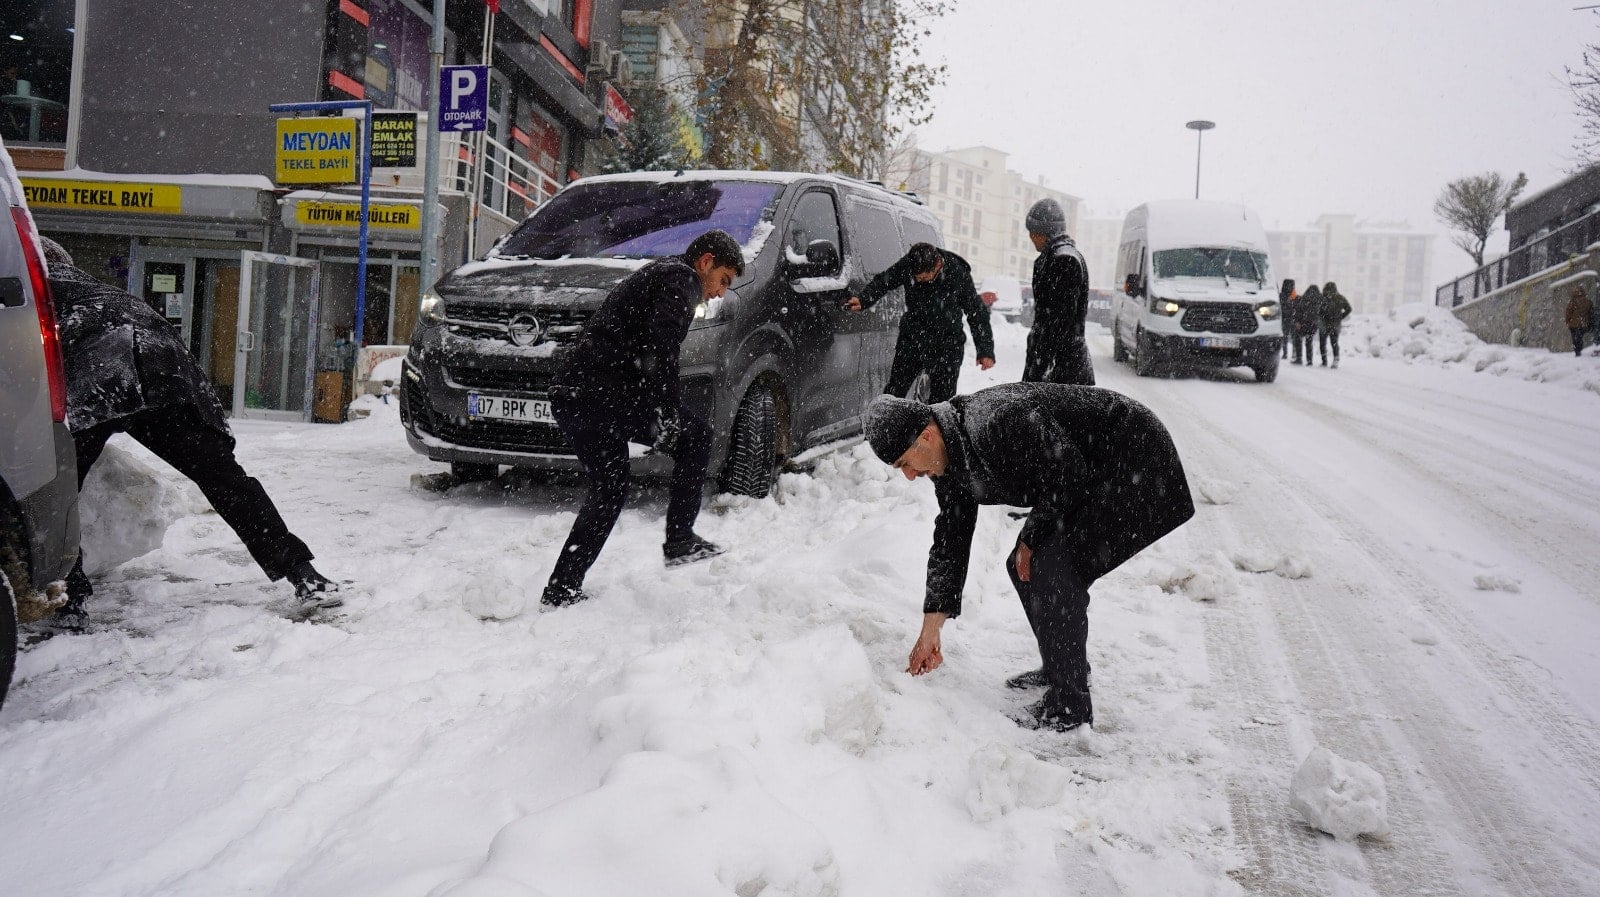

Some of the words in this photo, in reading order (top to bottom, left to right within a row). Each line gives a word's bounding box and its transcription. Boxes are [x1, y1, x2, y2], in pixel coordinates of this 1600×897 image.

[450, 69, 477, 110] P
[373, 120, 414, 130] BARAN
[444, 110, 482, 121] OTOPARK
[283, 131, 351, 151] MEYDAN
[373, 132, 413, 141] EMLAK
[282, 158, 316, 170] TEKEL
[23, 186, 67, 204] EYDAN
[72, 188, 117, 206] TEKEL
[121, 188, 154, 208] BAYİ
[306, 205, 342, 221] TÜTÜN
[345, 208, 410, 224] MAÜLLERİ
[477, 398, 494, 414] 07
[502, 400, 527, 417] BPK
